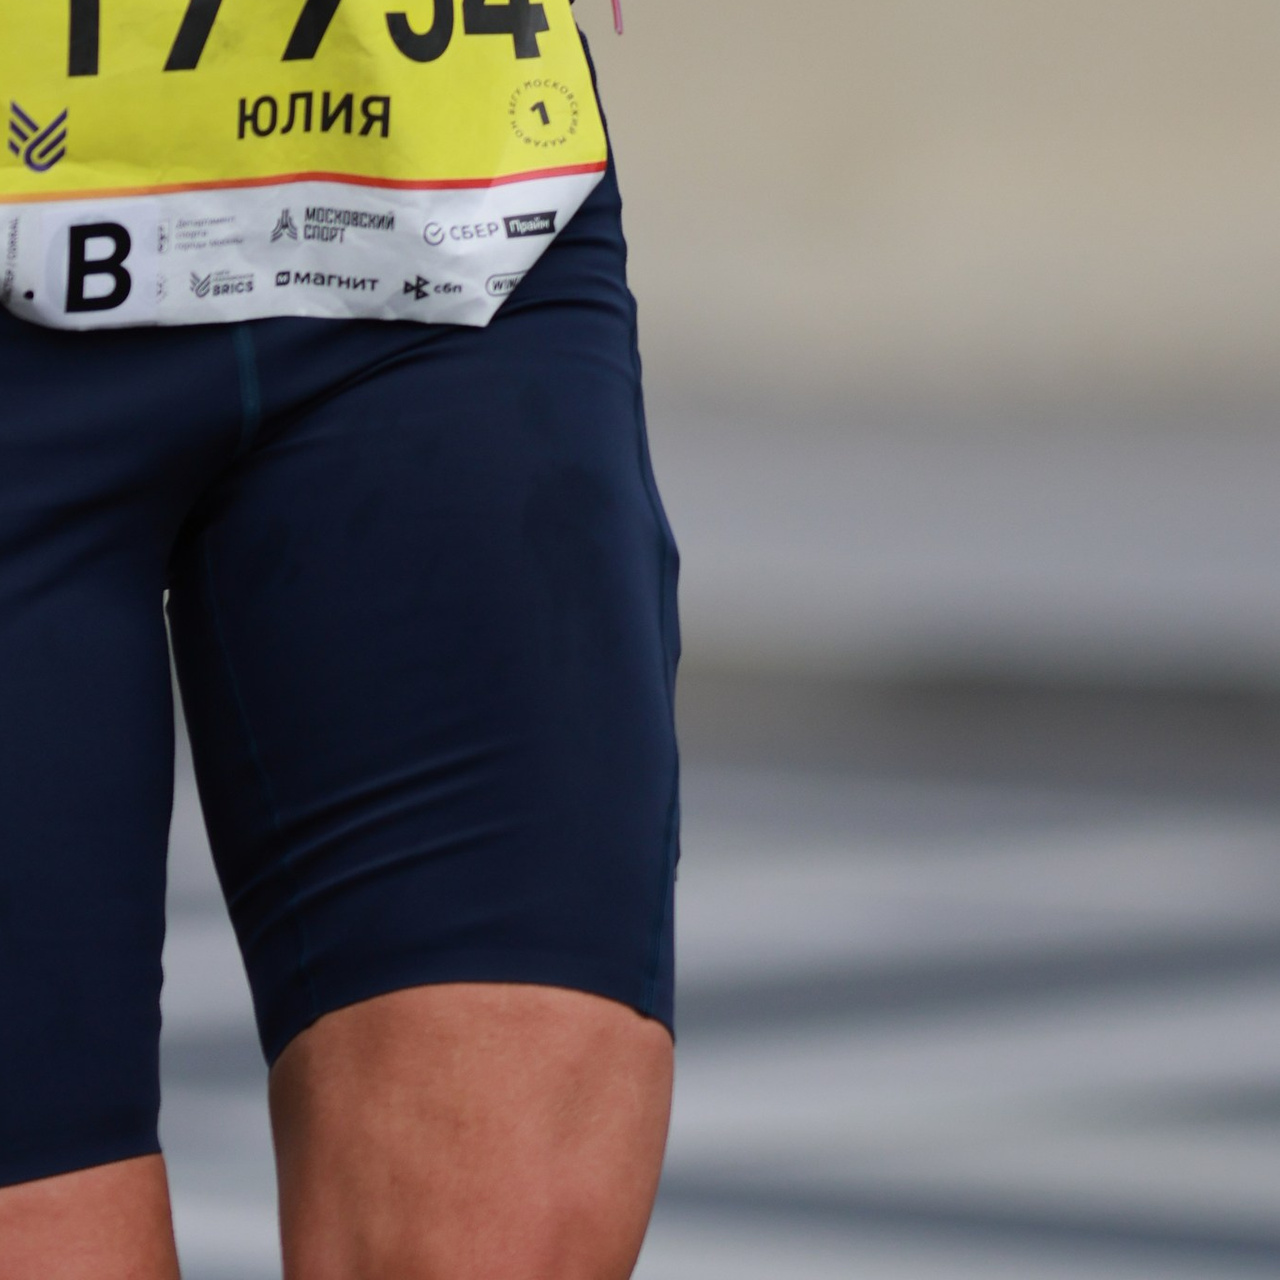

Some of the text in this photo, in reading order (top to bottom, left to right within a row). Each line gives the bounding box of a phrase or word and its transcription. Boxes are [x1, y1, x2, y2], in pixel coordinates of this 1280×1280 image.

[237, 91, 391, 139] ЮЛИЯ
[530, 101, 550, 125] 1
[304, 207, 395, 231] МОСКОВСКИЙ
[449, 216, 550, 240] СБЕР Прайм
[304, 224, 346, 243] СПОРТ
[213, 281, 253, 297] BRICS
[294, 272, 379, 291] магнит
[433, 283, 462, 294] сбп
